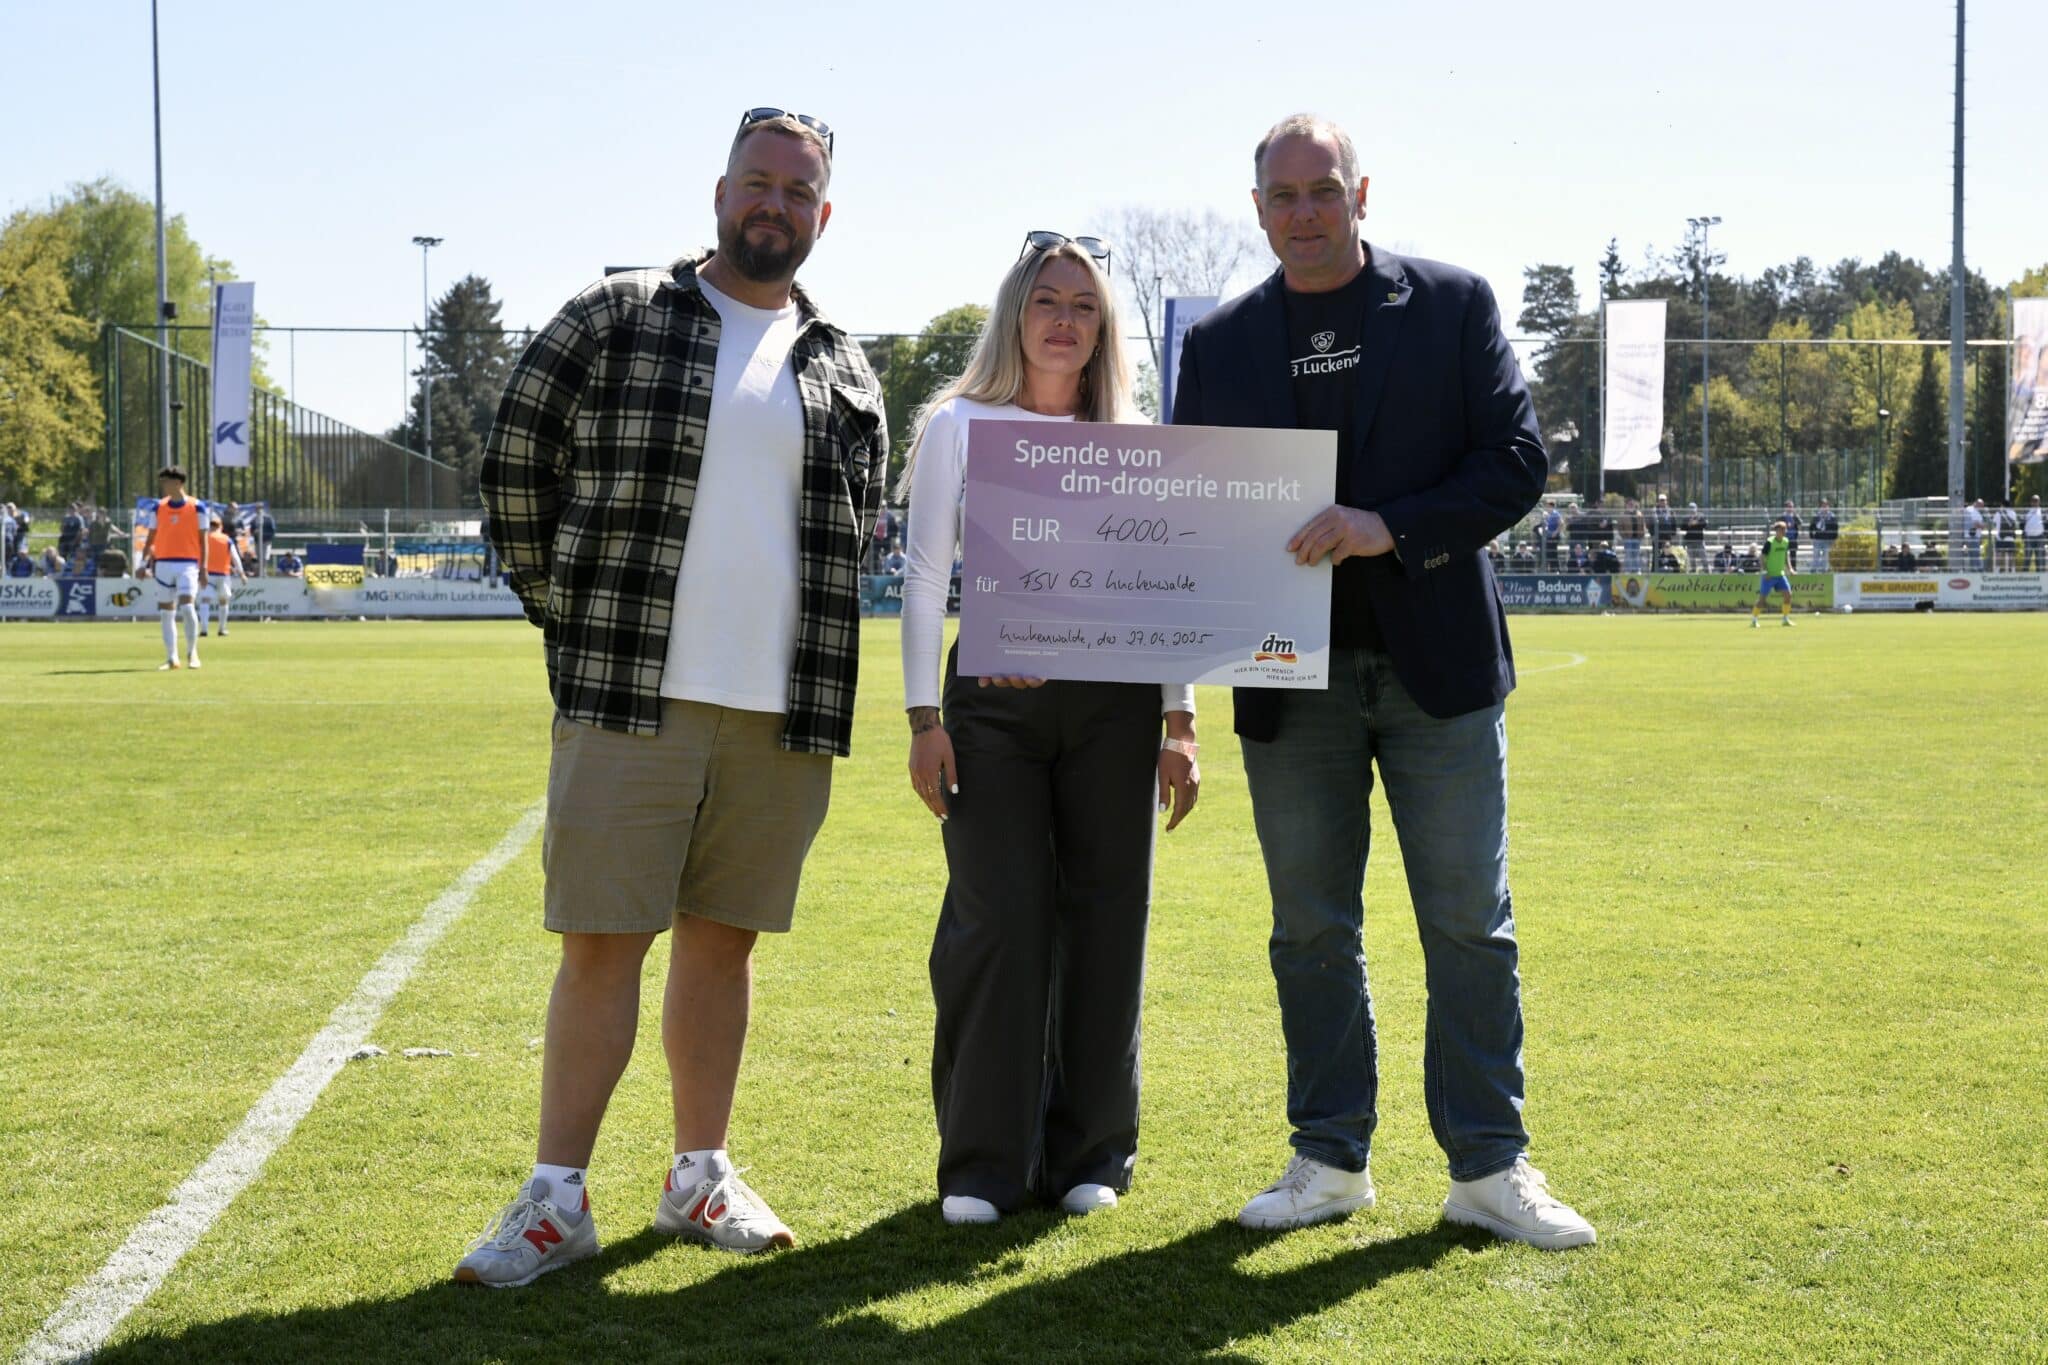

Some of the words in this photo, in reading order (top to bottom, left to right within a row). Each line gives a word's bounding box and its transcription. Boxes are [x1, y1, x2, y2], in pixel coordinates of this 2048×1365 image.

[1015, 439, 1109, 468] Spende
[1117, 448, 1162, 468] von
[1061, 469, 1218, 502] dm-drogerie
[1227, 477, 1301, 501] markt
[1012, 517, 1060, 542] EUR
[975, 576, 1000, 593] für
[1070, 570, 1093, 588] 63
[1106, 569, 1197, 592] Luckenwalde
[1537, 579, 1582, 592] Badura
[365, 590, 388, 601] MG
[394, 589, 448, 601] Klinikum
[1261, 634, 1294, 653] dm
